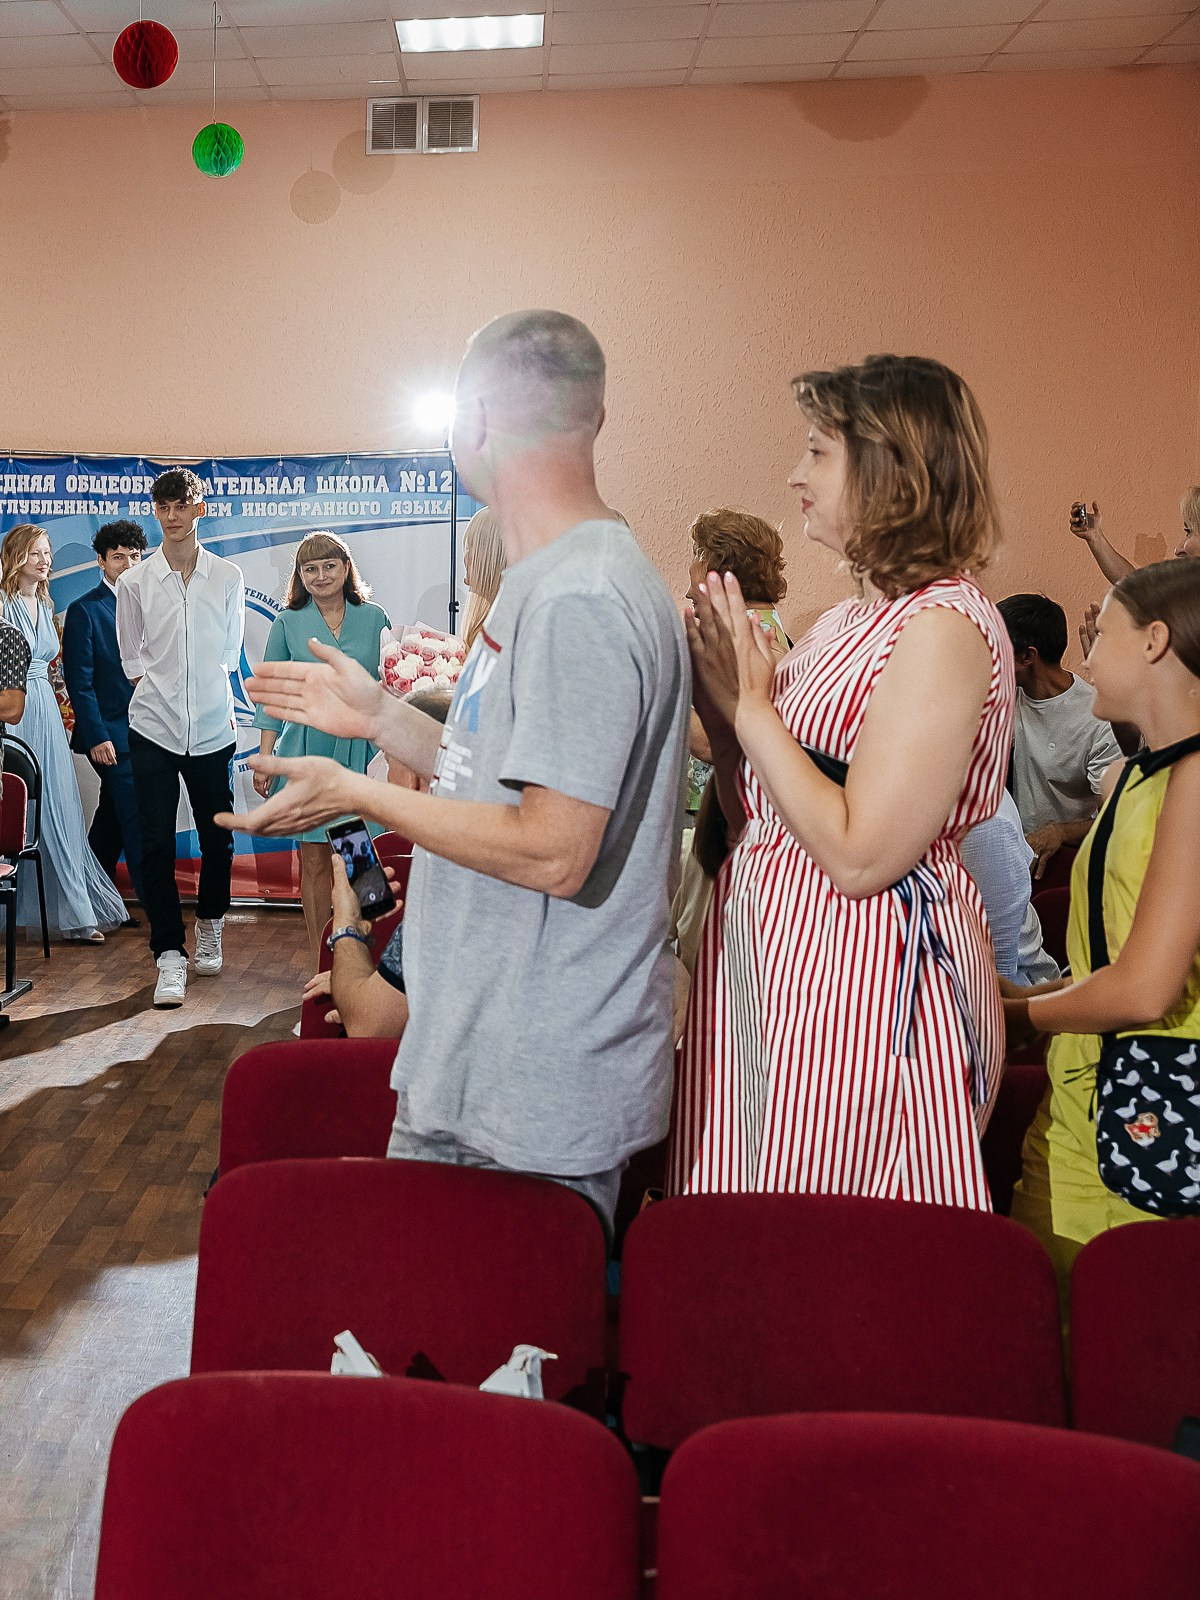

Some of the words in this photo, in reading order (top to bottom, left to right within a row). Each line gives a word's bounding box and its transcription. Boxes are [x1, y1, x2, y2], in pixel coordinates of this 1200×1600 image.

[65, 474, 306, 496] ОБЩЕОБРАТЕЛЬНАЯ
[316, 475, 390, 494] ШКОЛА
[400, 470, 452, 493] №12
[241, 500, 381, 518] ИНОСТРАННОГО
[390, 500, 451, 516] ЯЗЫКА
